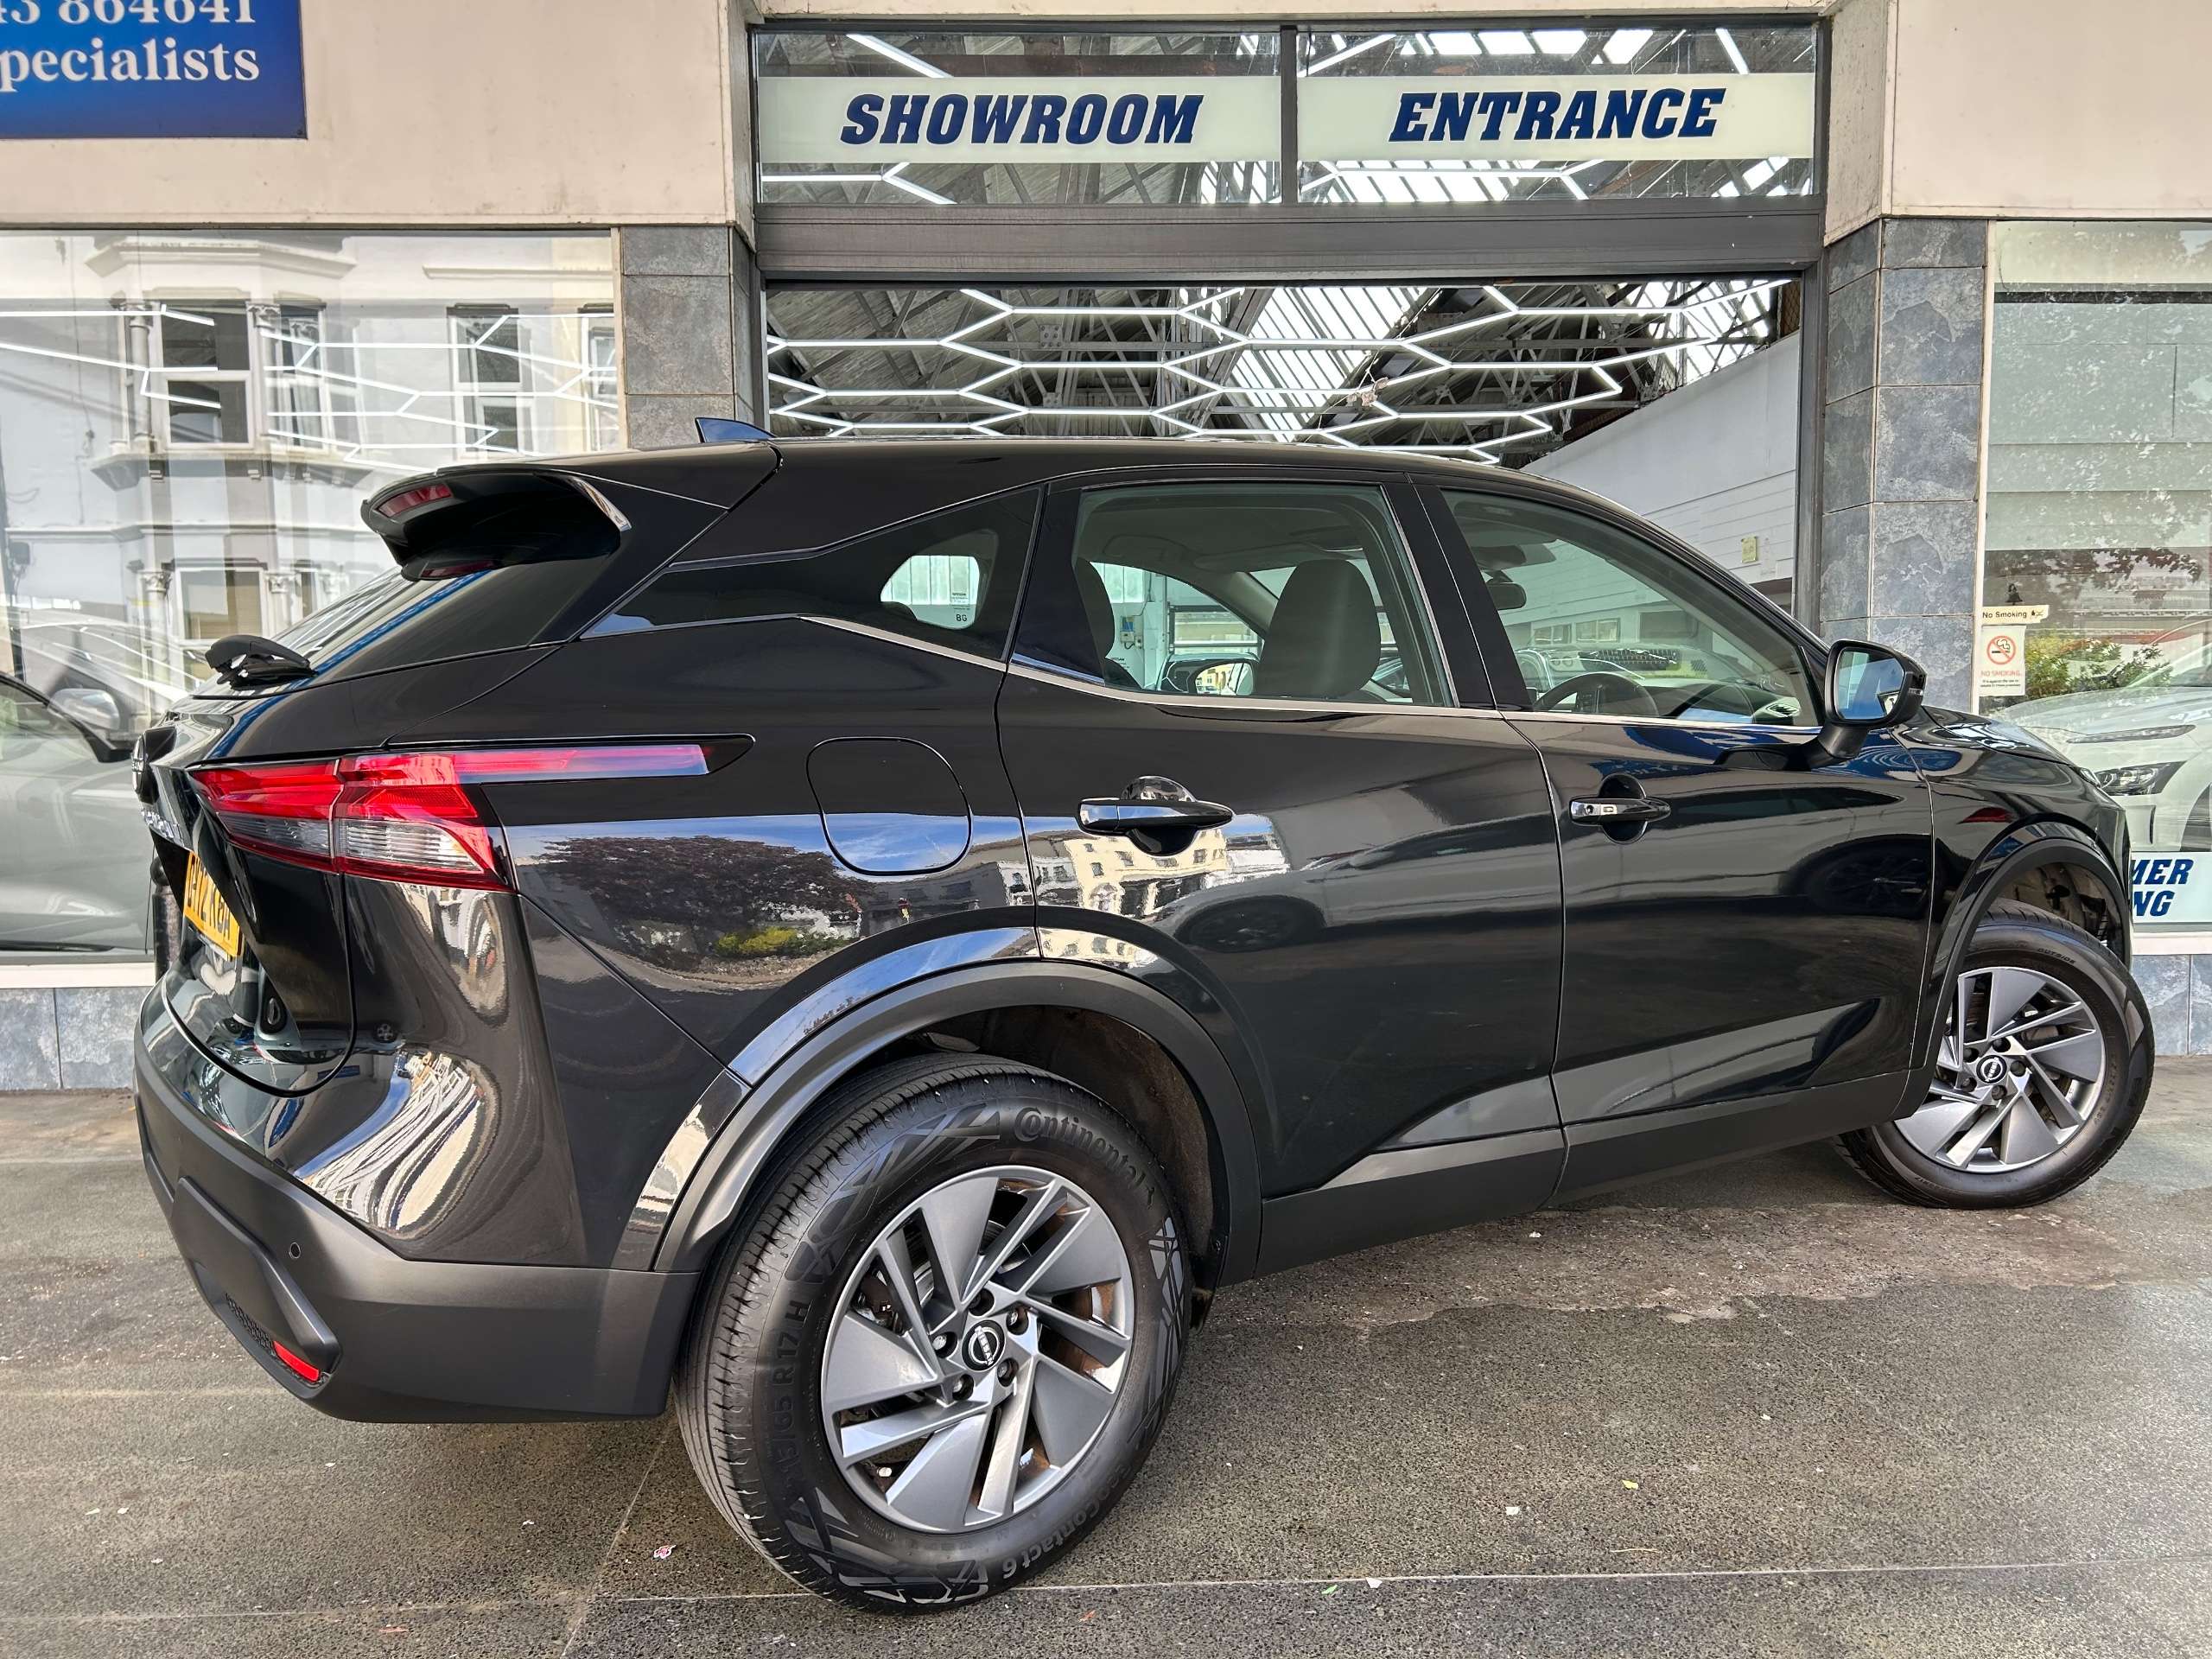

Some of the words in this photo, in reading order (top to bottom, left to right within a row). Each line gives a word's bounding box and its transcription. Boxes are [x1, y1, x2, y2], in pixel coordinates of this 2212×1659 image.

[0, 0, 41, 24] 3
[0, 37, 259, 92] pecialists
[840, 93, 1205, 145] SHOWROOM
[1388, 87, 1727, 143] ENTRANCE
[1014, 1107, 1147, 1189] Continental
[974, 1325, 995, 1367] NISSAN
[1001, 1557, 1017, 1580] 6
